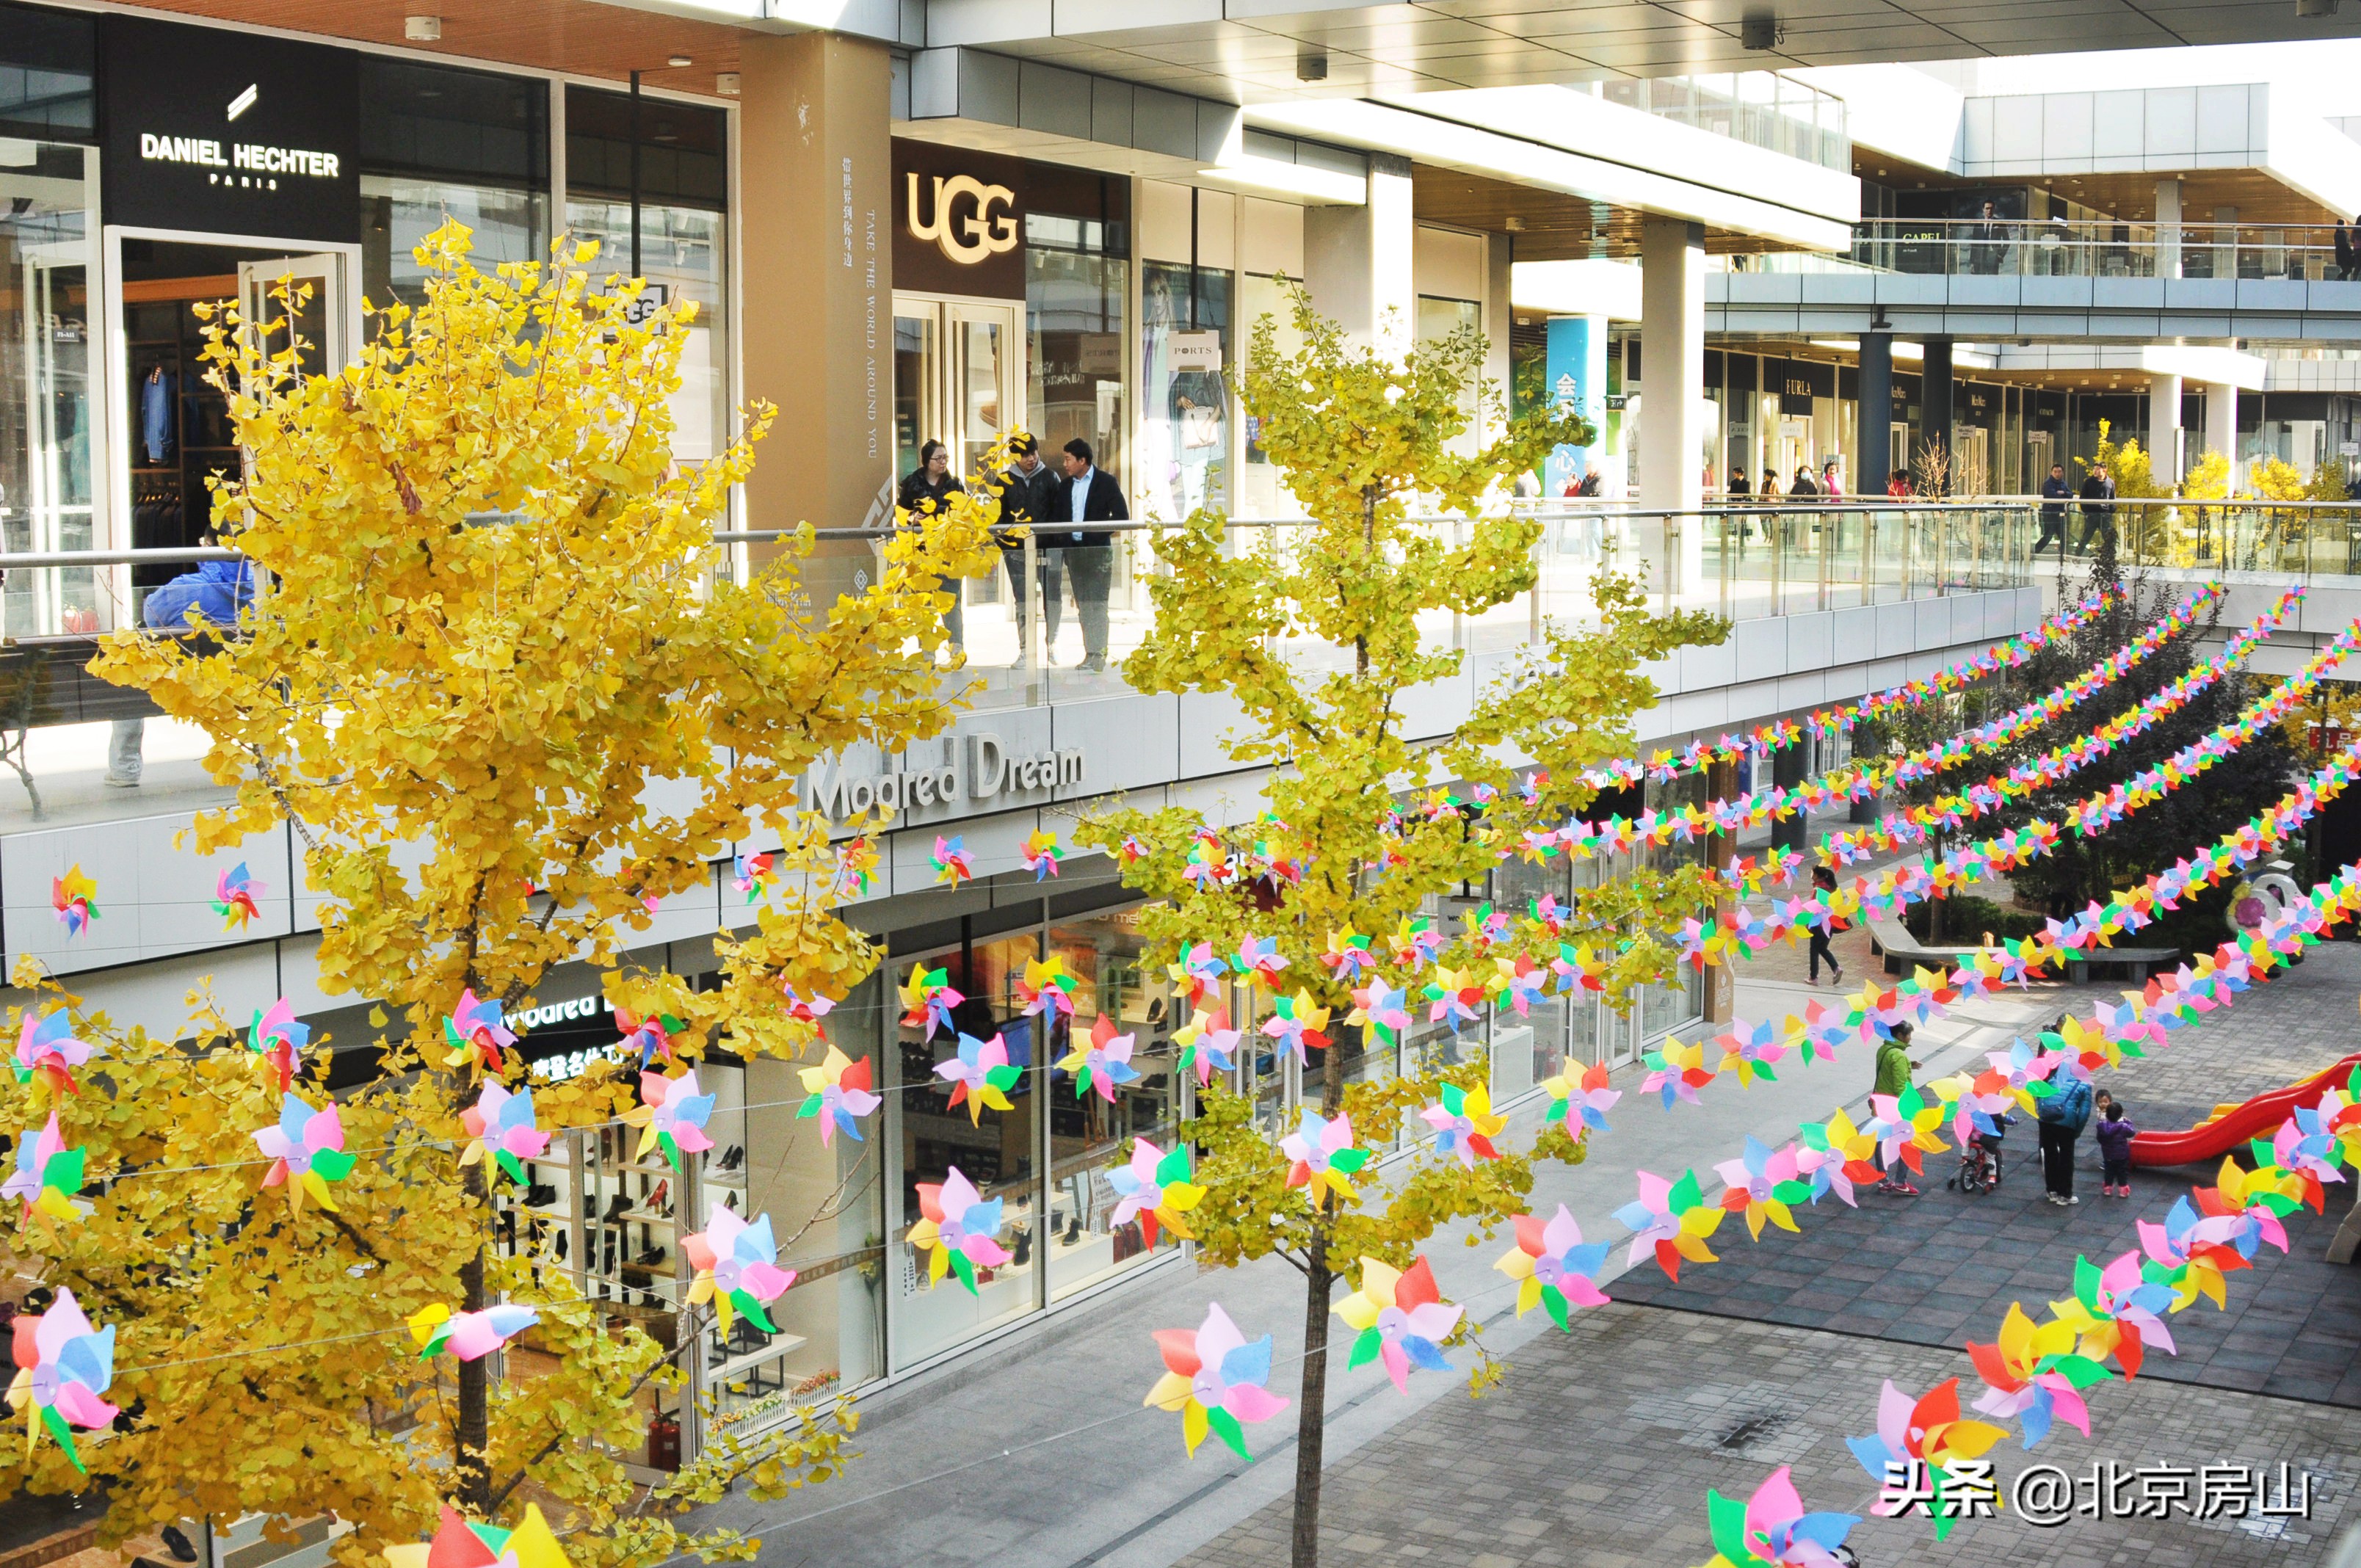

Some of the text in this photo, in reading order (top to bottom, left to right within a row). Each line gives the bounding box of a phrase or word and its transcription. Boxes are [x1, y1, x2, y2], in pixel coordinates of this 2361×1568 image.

[141, 133, 338, 177] DANIEL HECHTER
[209, 173, 277, 190] PARIS
[842, 157, 853, 267] 带世界到你身边
[907, 172, 1018, 264] UGG
[866, 209, 877, 459] TAKE THE WORLD AROUND YOU
[1556, 372, 1577, 473] 会员心
[1786, 379, 1811, 396] FURLA
[805, 733, 1087, 819] Modred Dream
